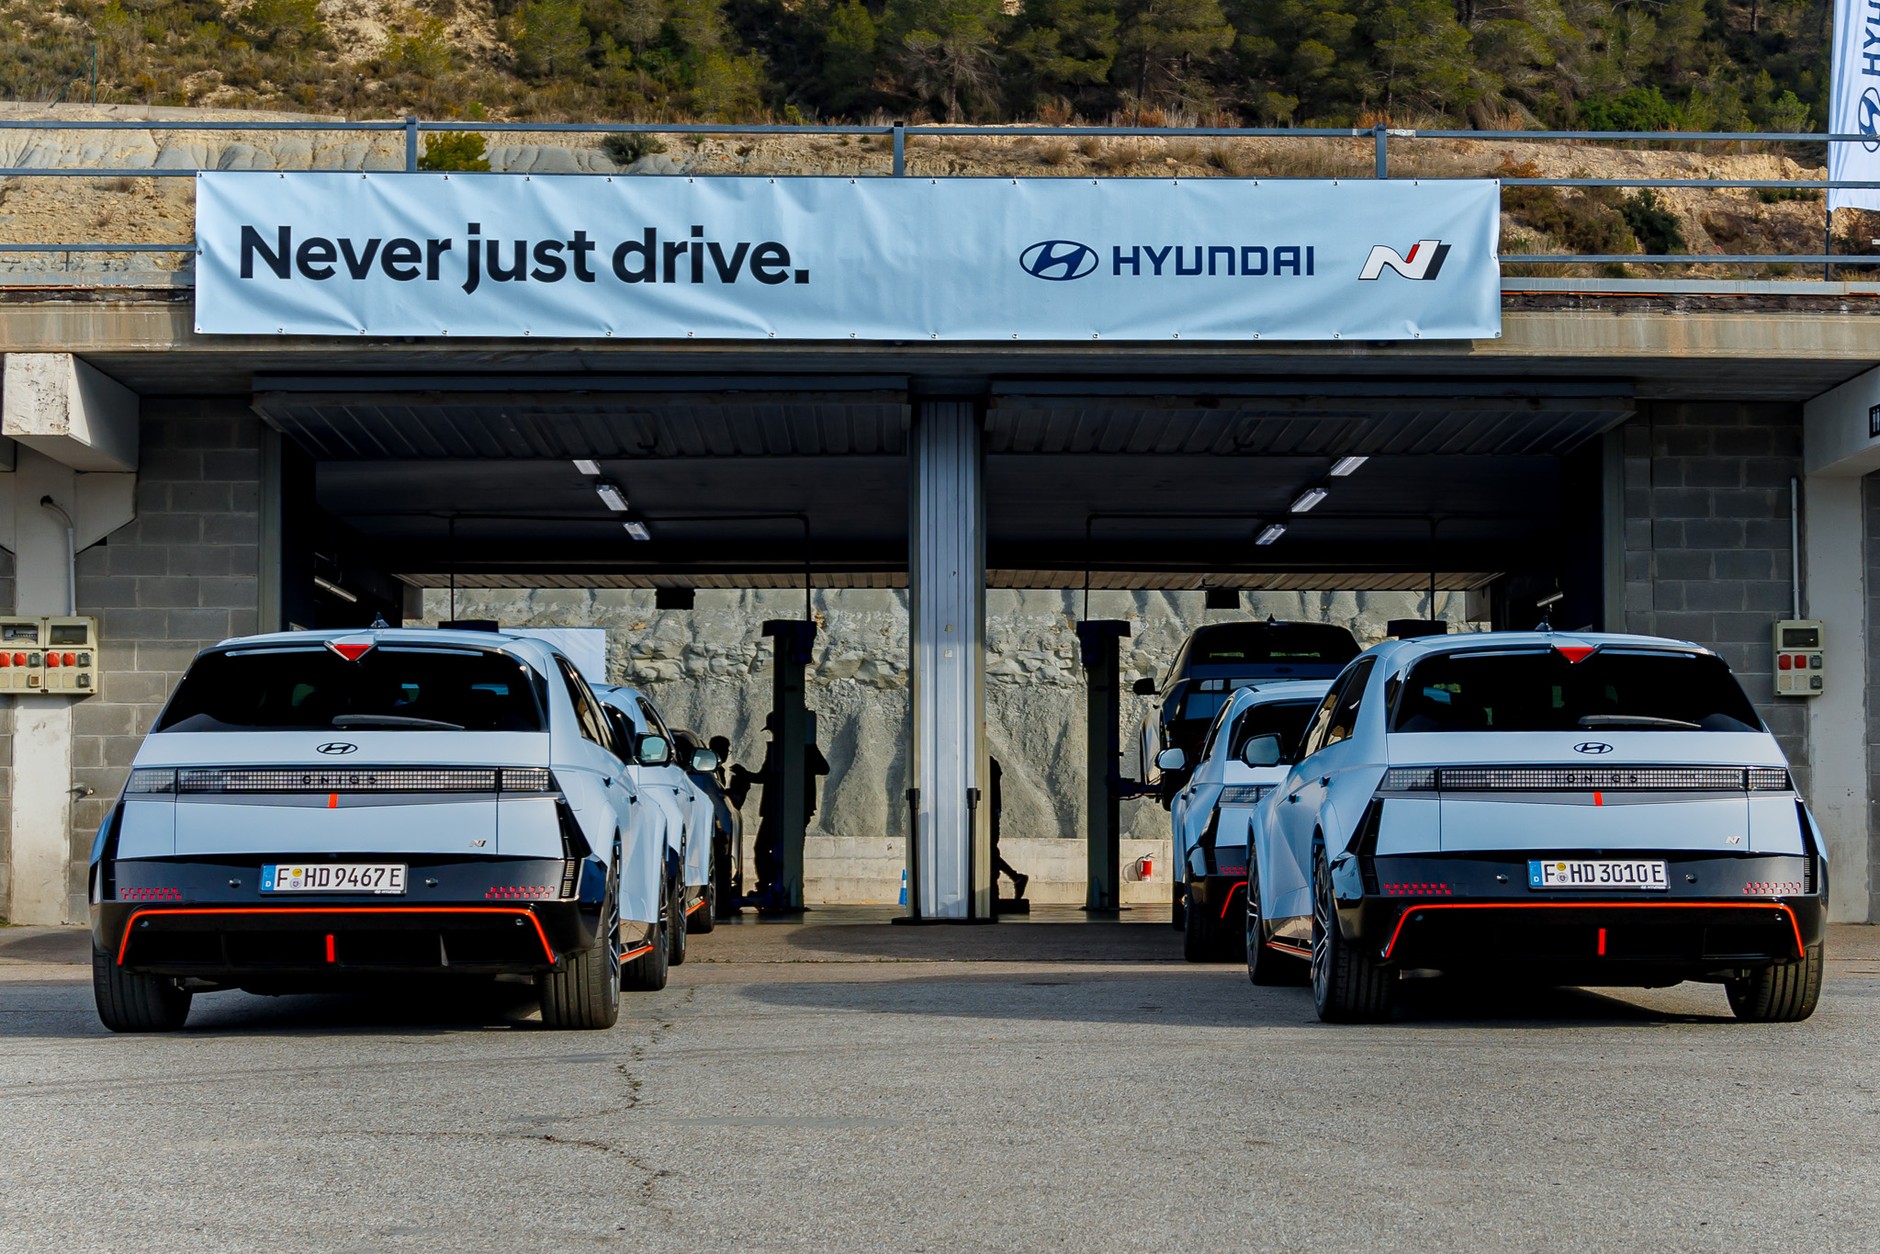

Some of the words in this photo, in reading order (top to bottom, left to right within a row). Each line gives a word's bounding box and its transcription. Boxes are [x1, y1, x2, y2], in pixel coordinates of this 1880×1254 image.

[240, 226, 451, 281] Never
[462, 223, 595, 294] just
[613, 226, 809, 284] drive.
[1113, 246, 1314, 275] HYUNDAI
[276, 868, 290, 887] F
[304, 867, 331, 887] HD
[1544, 864, 1556, 883] F
[1569, 863, 1596, 883] HD
